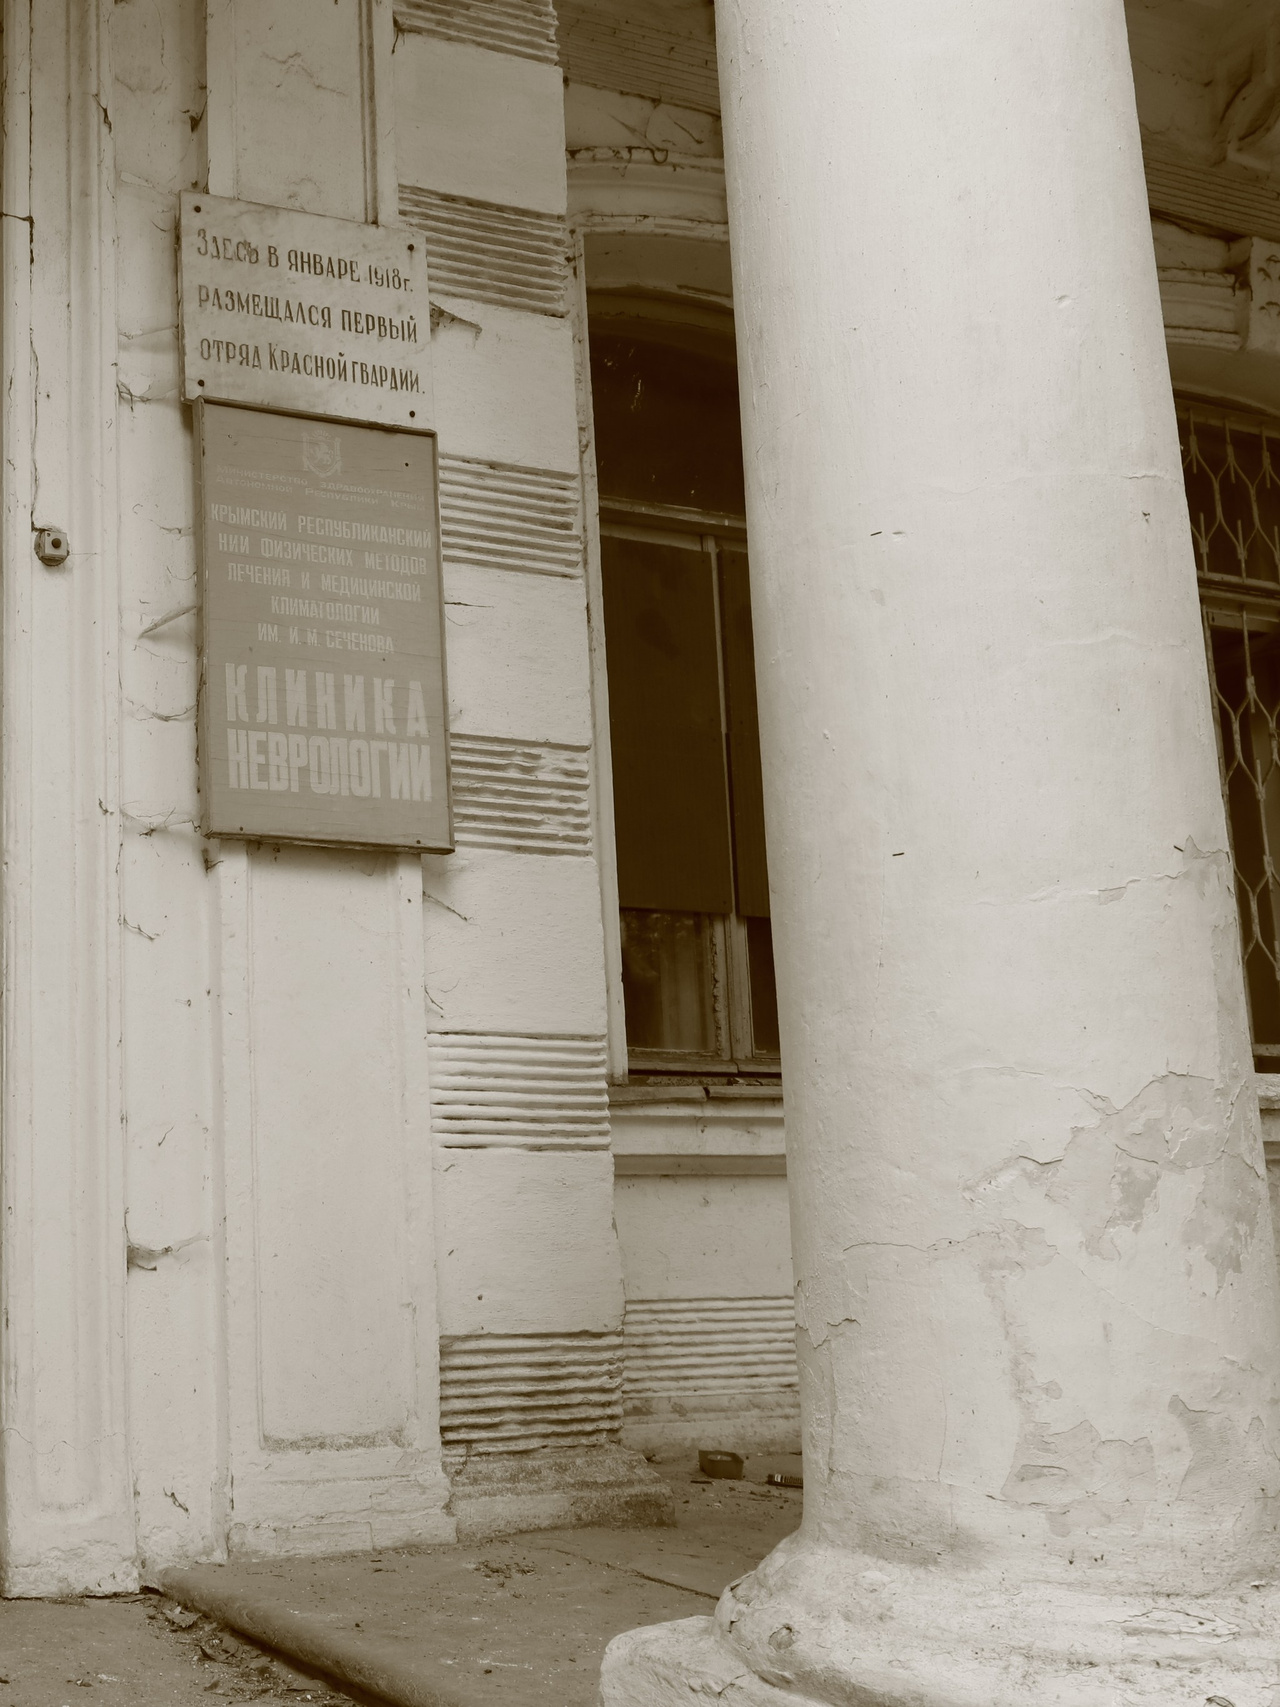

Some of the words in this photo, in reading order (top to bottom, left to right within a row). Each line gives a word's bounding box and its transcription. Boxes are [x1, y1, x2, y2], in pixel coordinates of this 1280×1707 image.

[197, 228, 259, 264] ЗДЕСЬ
[268, 245, 279, 268] В
[287, 249, 361, 283] ЯНВАРЕ
[198, 284, 332, 329] РАЗМЕЩАЛСЯ
[341, 309, 418, 344] ПЕРВЫЙ
[199, 338, 262, 370] ОТРЯД
[269, 342, 348, 382] КРАСНОЙ
[210, 502, 287, 532] КРЫМСКИЙ
[297, 514, 431, 549] РЕСПУБЛИКАНСКИЙ
[218, 532, 250, 554] НИИ
[260, 537, 354, 568] ФИЗИЧЕСКИХ
[365, 551, 427, 577] МЕТОДОВ
[227, 562, 291, 588] ЛЕЧЕНИЯ
[301, 571, 310, 590] И
[321, 572, 422, 602] МЕДИЦИНСКОЙ
[271, 595, 380, 626] КЛИМАТОЛОГИИ
[257, 622, 282, 643] ИМ.
[326, 630, 395, 654] СЕЧЕНОВА
[225, 662, 430, 738] КЛИНИКА
[227, 728, 432, 802] НЕВРОЛОГИИ
